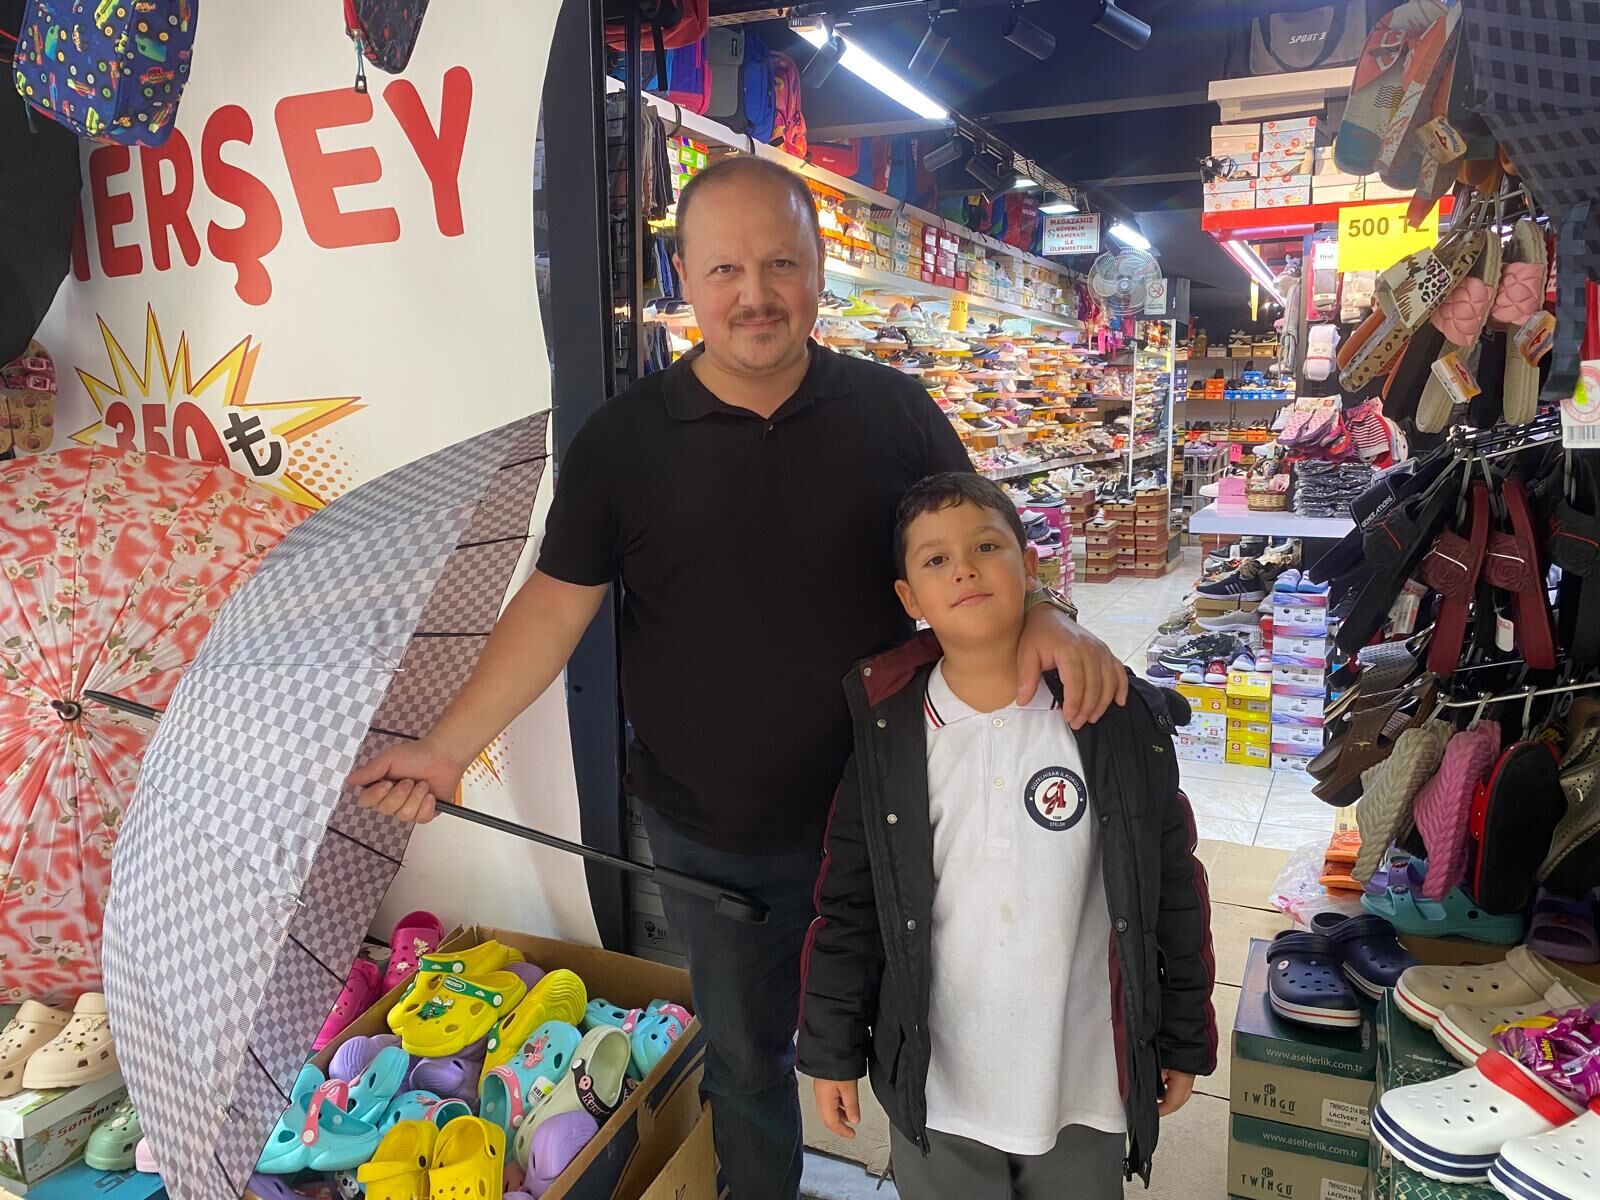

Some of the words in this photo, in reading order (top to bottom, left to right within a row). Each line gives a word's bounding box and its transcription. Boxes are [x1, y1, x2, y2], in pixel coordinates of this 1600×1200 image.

[71, 66, 473, 306] ERŞEY
[1348, 217, 1389, 237] 500
[1361, 496, 1393, 528] GENERATIONS
[1266, 1048, 1364, 1073] www.aselterlik.com.tr
[1541, 1039, 1554, 1061] hobby
[1262, 1131, 1359, 1158] www.aselterlik.com.tr
